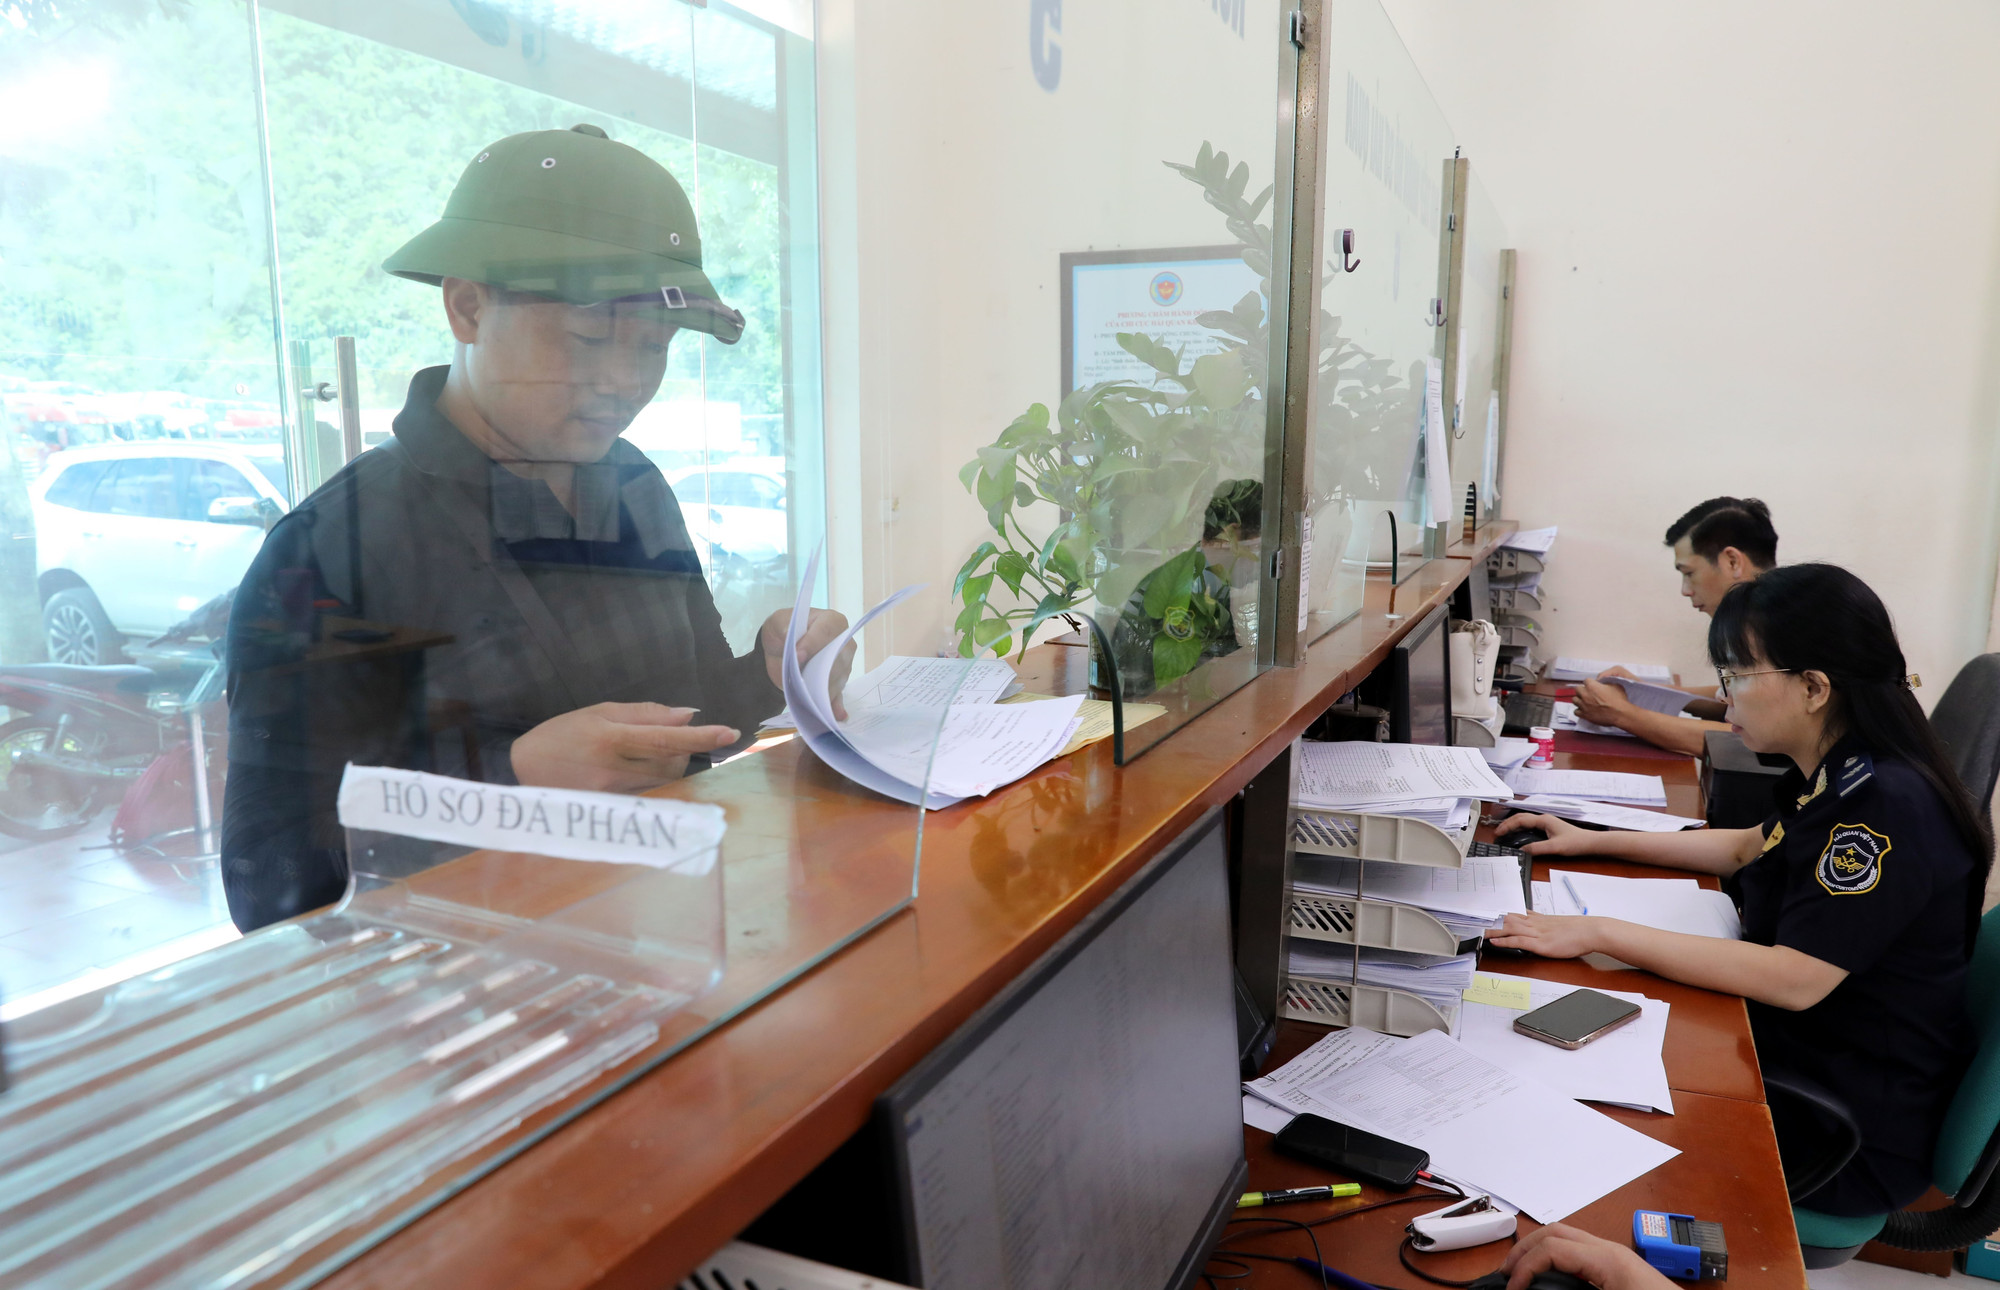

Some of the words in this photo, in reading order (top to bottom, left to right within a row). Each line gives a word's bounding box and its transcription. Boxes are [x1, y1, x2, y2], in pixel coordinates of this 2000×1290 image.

[438, 786, 487, 827] SƠ
[565, 798, 682, 850] PHÂN
[1869, 840, 1880, 854] NAM
